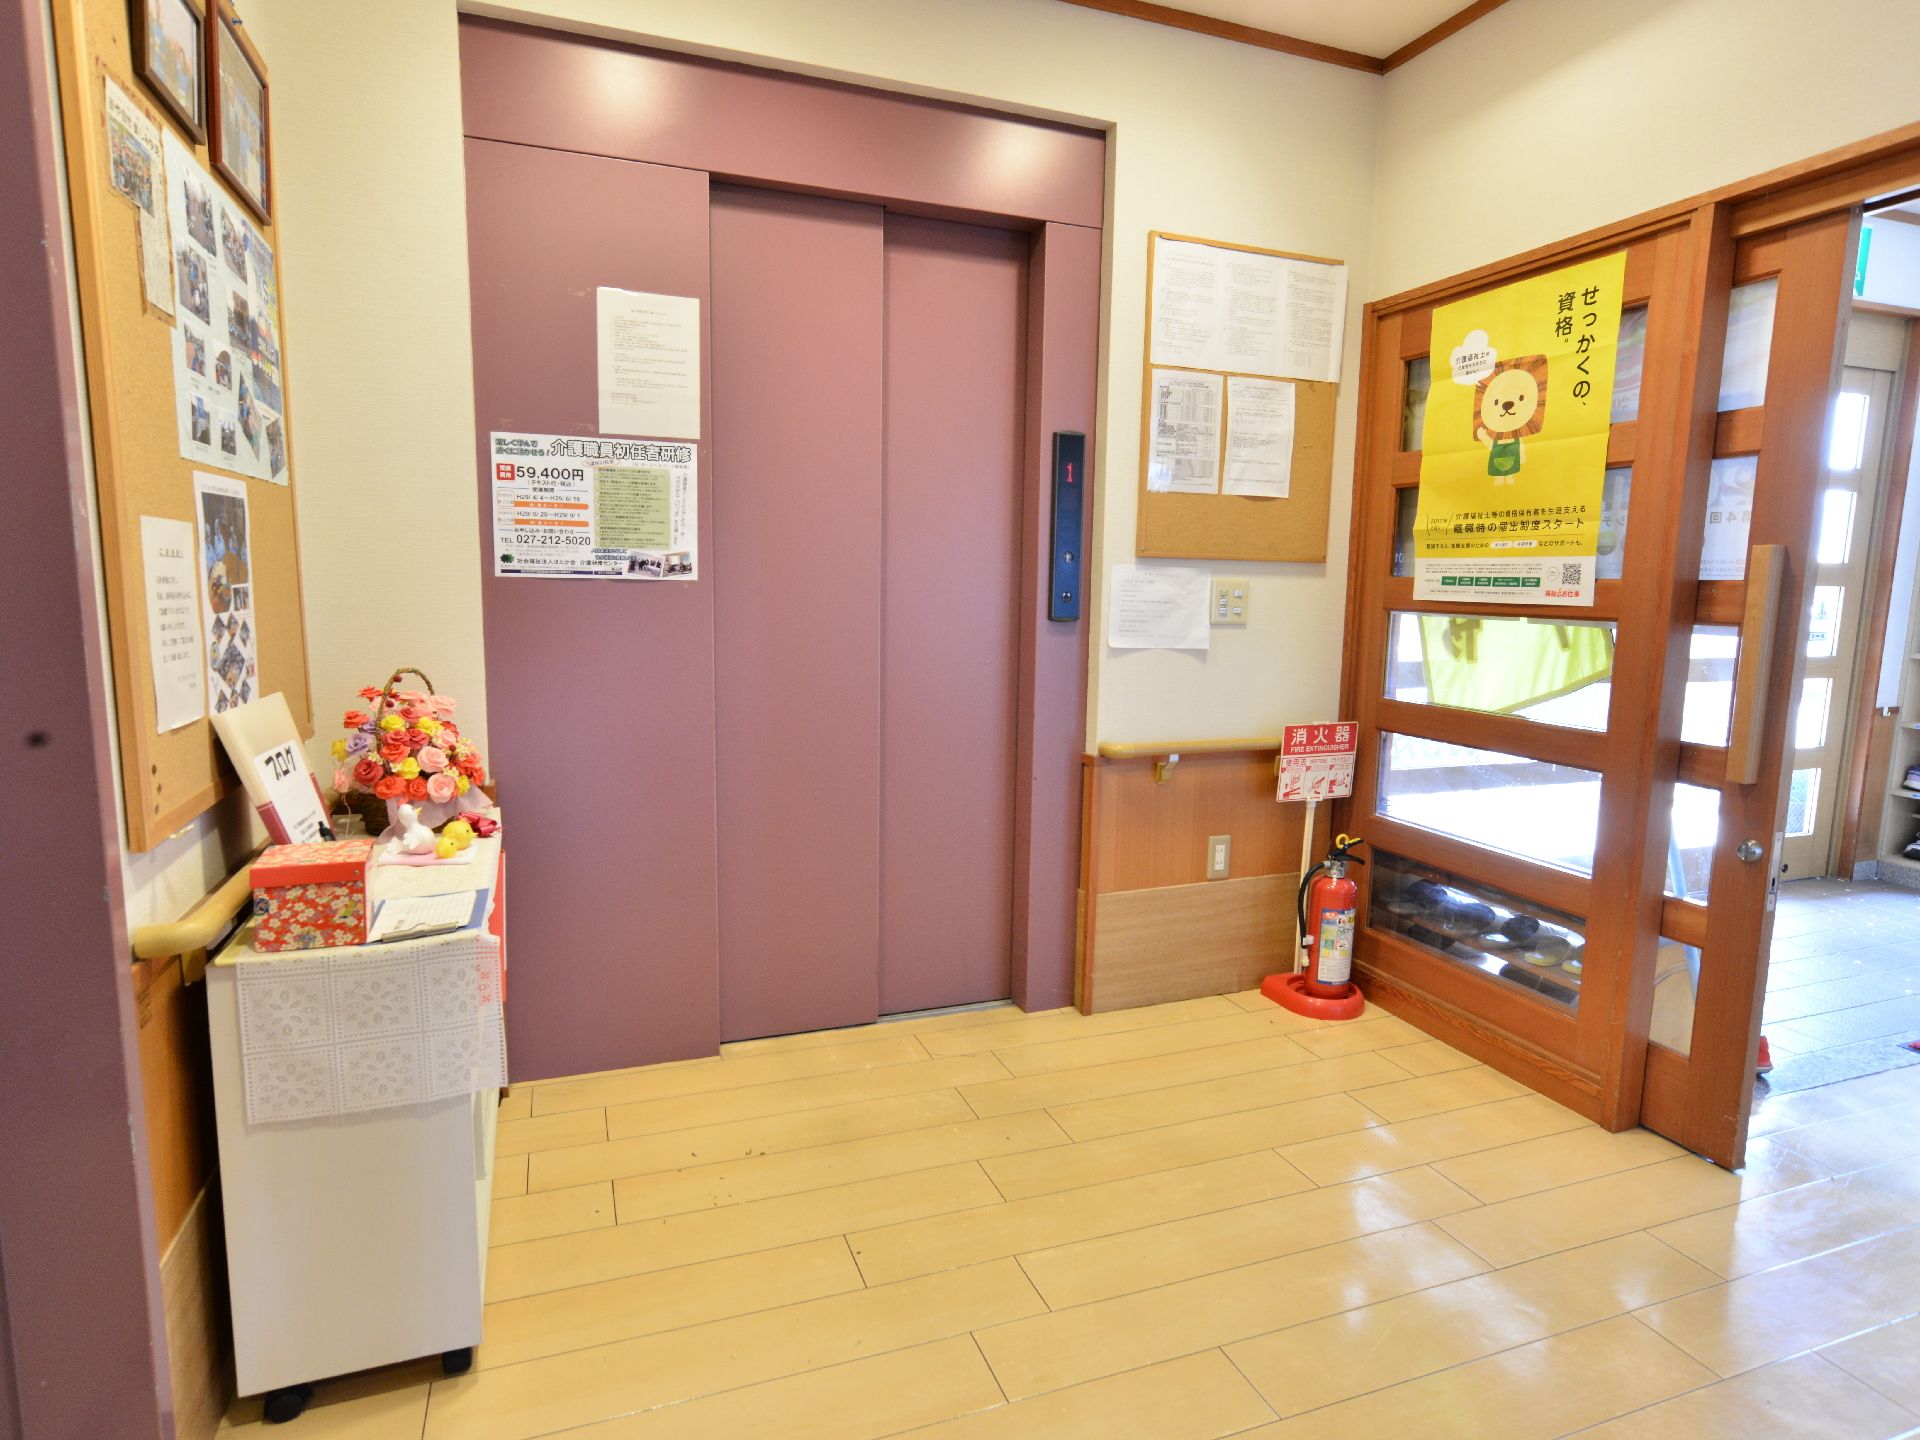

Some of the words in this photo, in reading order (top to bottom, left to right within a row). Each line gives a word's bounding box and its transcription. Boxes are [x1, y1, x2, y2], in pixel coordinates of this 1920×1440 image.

[550, 438, 692, 463] 介護職員初任者研修
[516, 466, 584, 481] 59,400円
[1066, 463, 1073, 484] 1
[516, 534, 592, 546] 027-212-5020
[1290, 725, 1350, 746] 消火器
[1305, 743, 1350, 752] EXTINGUISHER
